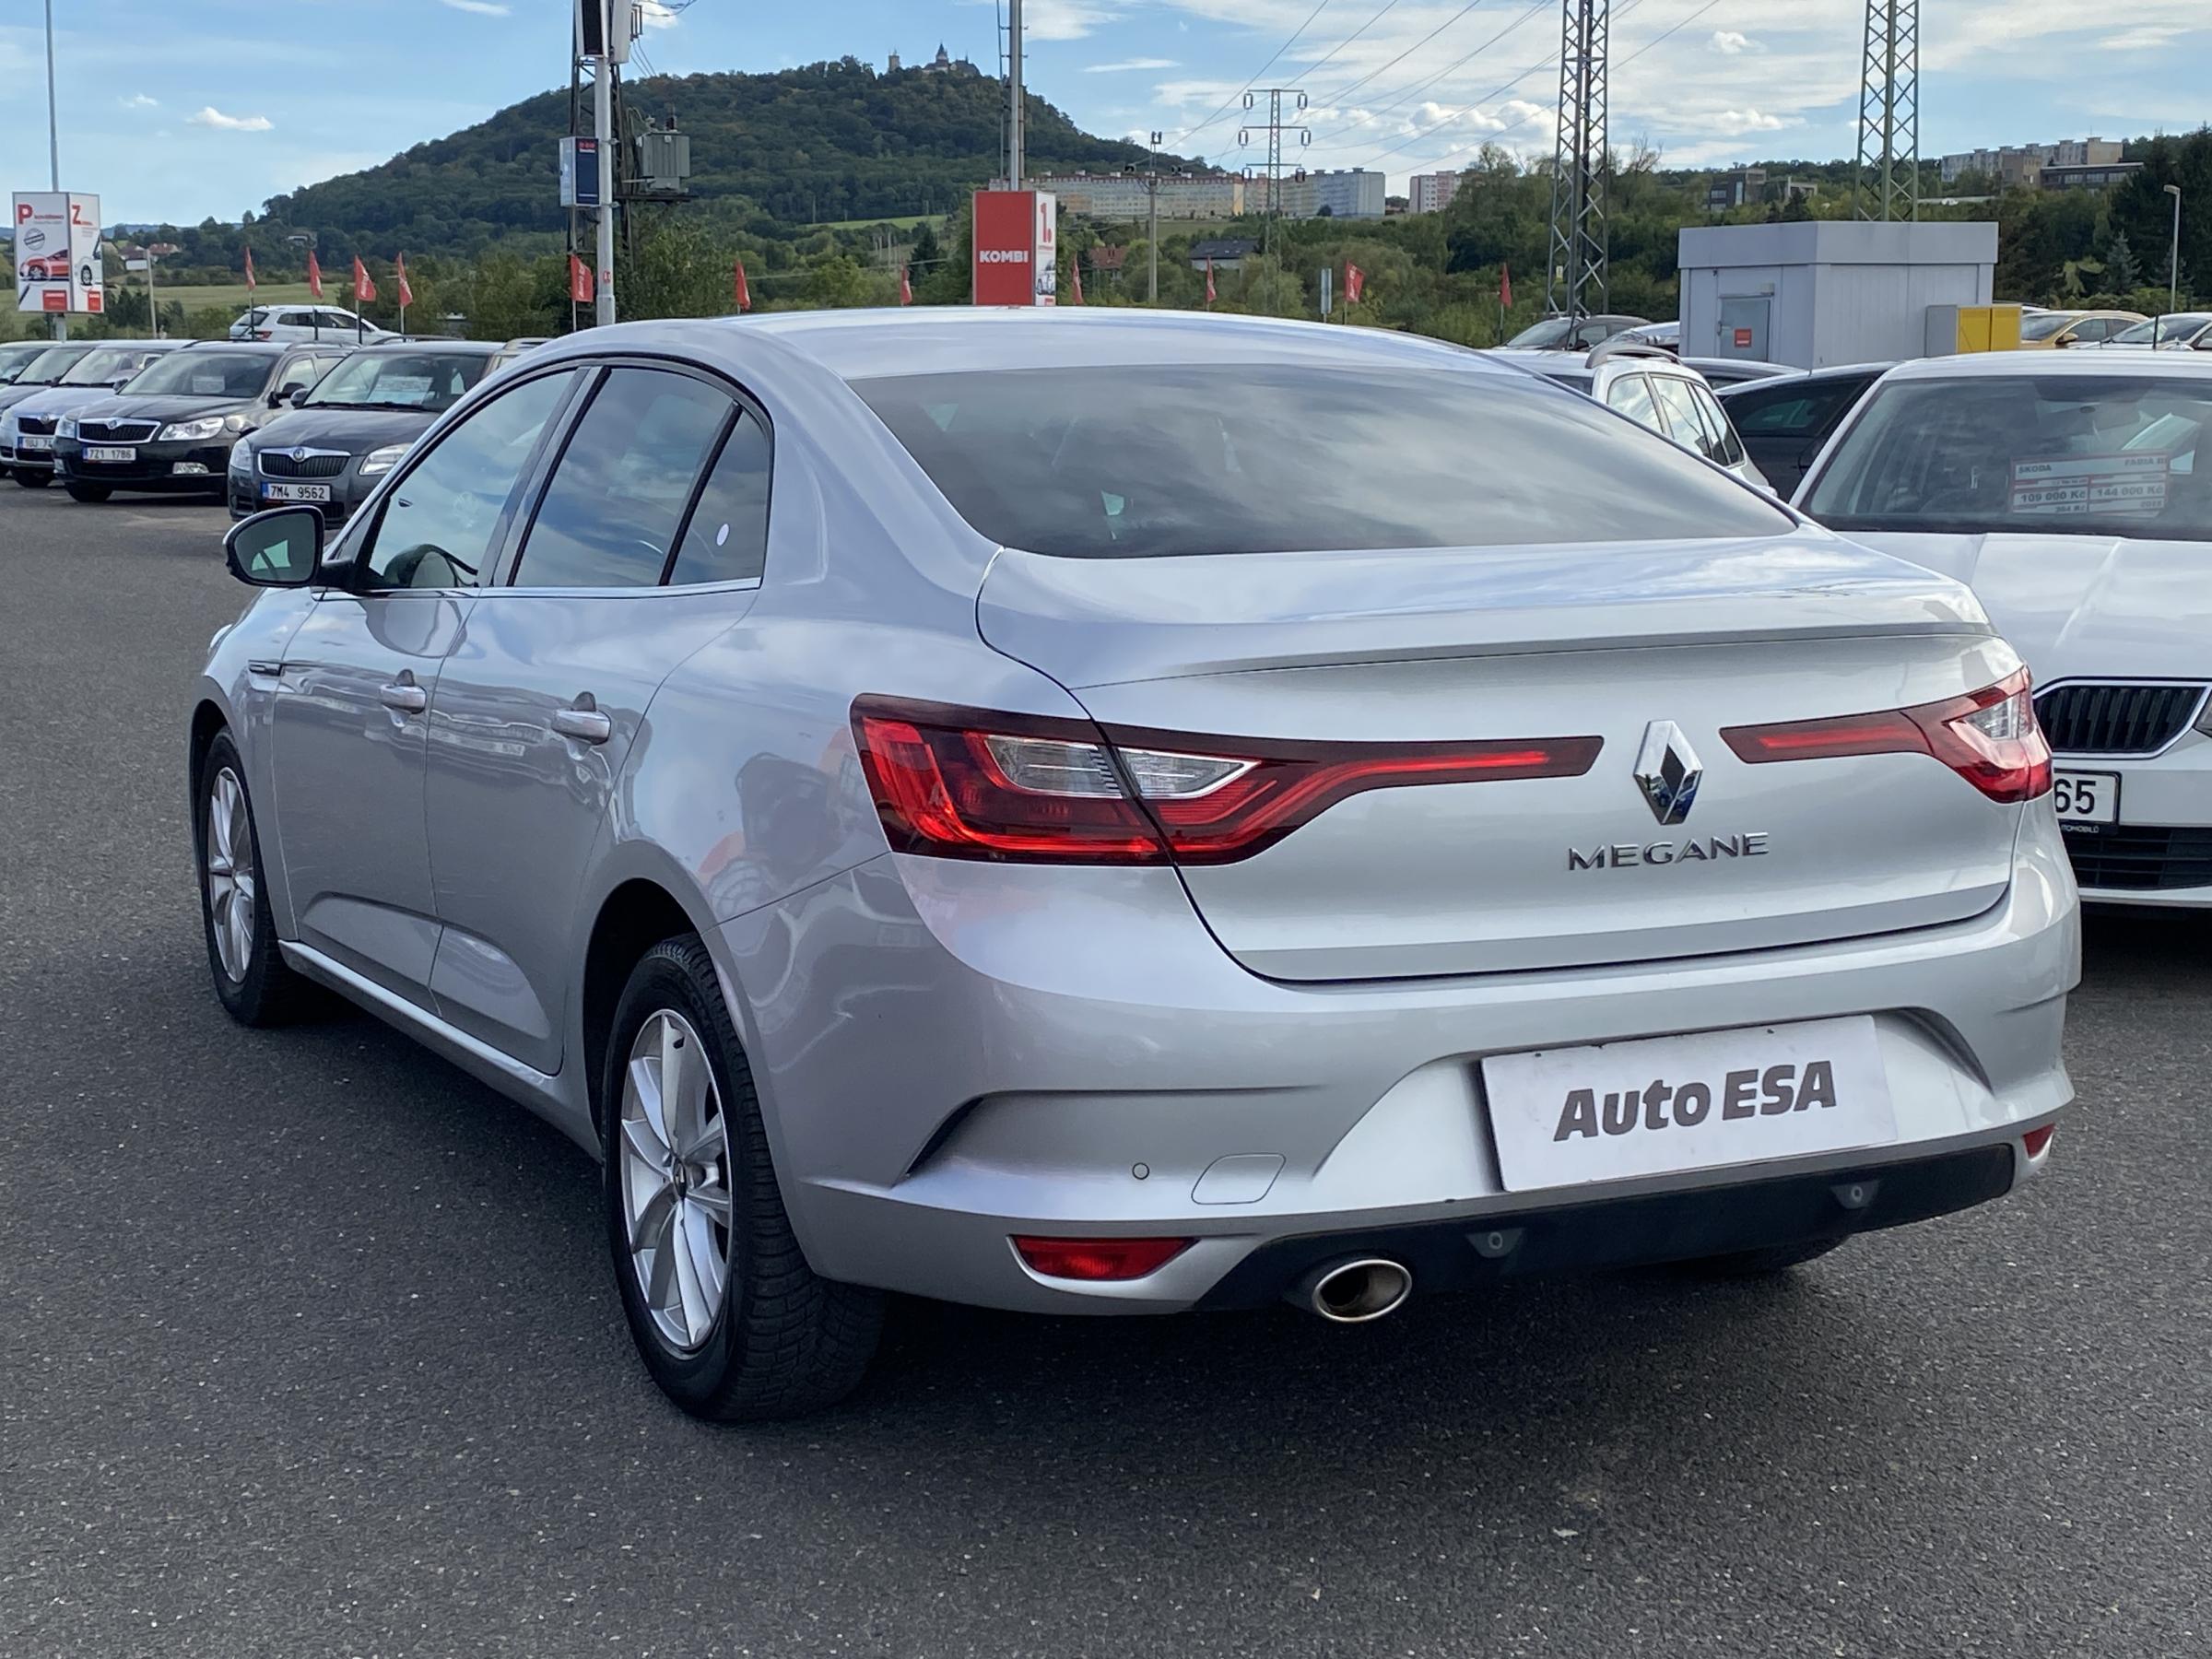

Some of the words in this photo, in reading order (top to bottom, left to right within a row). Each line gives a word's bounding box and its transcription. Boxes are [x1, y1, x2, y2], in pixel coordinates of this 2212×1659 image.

[979, 250, 1029, 263] KOMBI
[270, 485, 289, 498] 7M4
[297, 486, 324, 499] 9562
[2020, 493, 2042, 503] 109
[2045, 491, 2067, 500] 000
[2097, 487, 2119, 497] 144
[2122, 486, 2144, 496] 000
[2054, 779, 2096, 815] 65
[1568, 831, 1770, 871] MEGANE
[1553, 1078, 1712, 1143] Auto
[1722, 1059, 1837, 1122] ESA
